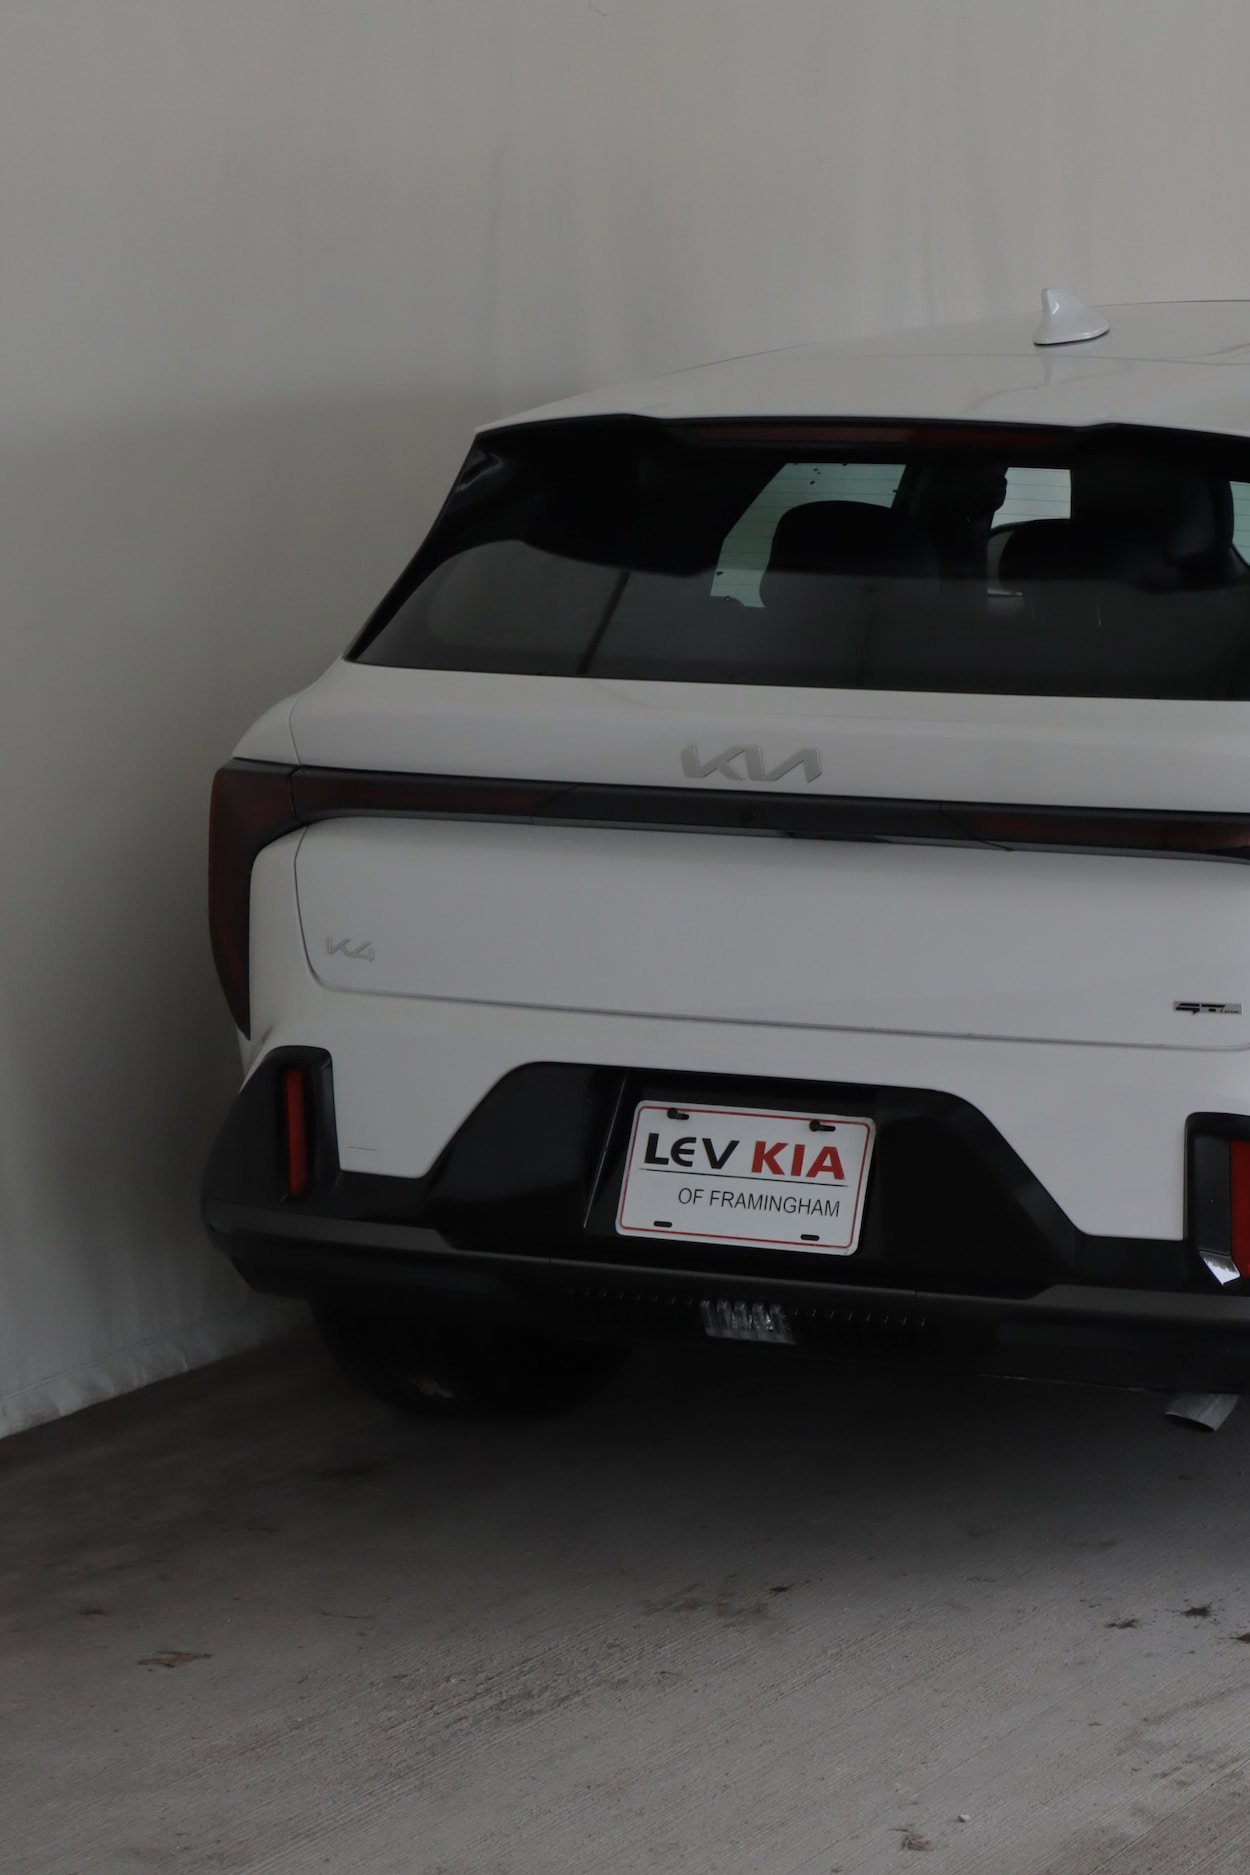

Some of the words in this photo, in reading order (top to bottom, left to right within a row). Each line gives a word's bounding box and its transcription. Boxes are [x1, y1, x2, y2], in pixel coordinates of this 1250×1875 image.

[680, 743, 822, 784] KIA
[643, 1132, 740, 1170] LEV
[751, 1140, 845, 1180] KIA
[678, 1187, 704, 1206] OF
[709, 1190, 840, 1217] FRAMINGHAM
